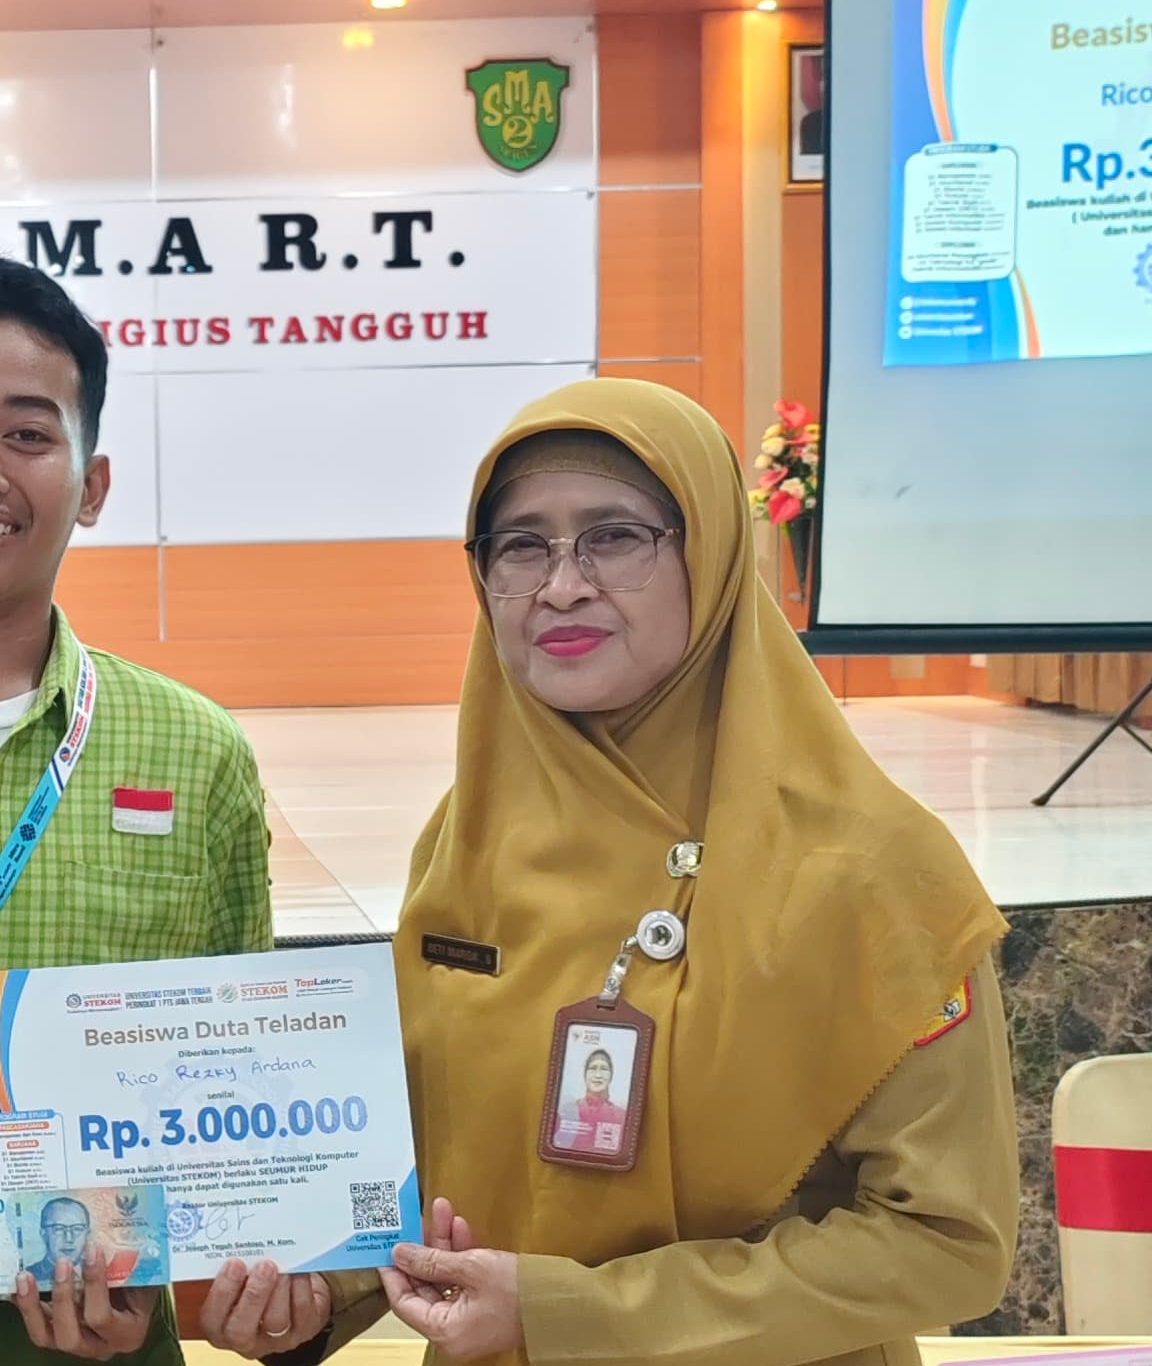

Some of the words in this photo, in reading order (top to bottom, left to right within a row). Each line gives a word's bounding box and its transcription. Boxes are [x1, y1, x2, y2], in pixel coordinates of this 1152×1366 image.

[1051, 17, 1152, 50] Beasis
[483, 70, 554, 126] SMA
[503, 116, 533, 148] 2
[104, 318, 231, 348] IGIUS
[248, 311, 489, 345] TANGGUH
[84, 1024, 189, 1046] Beasiswa
[195, 1020, 249, 1039] Duta
[254, 1012, 347, 1035] Teladan
[178, 1047, 219, 1058] Diberikan
[221, 1046, 256, 1056] kepada:
[117, 1071, 158, 1087] Rico
[251, 1057, 317, 1075] Ardana
[207, 1090, 235, 1100] senilai
[79, 1114, 151, 1159] Rp.
[159, 1095, 368, 1145] 3.000.000
[96, 1167, 136, 1176] Beasiswa
[137, 1165, 164, 1173] kuliah
[166, 1163, 175, 1171] di
[177, 1161, 225, 1171] Universitas
[227, 1159, 250, 1167] Sains
[252, 1157, 268, 1165] dan
[271, 1155, 313, 1164] Teknologi
[315, 1151, 359, 1161] Komputer
[128, 1176, 180, 1187] (Universitas
[181, 1172, 222, 1181] STEKOM)
[224, 1170, 256, 1178] berlaku
[258, 1166, 296, 1175] SEUMUR
[298, 1164, 328, 1172] HIDUP
[194, 1182, 219, 1191] dapat
[222, 1180, 267, 1190] digunakan
[269, 1177, 288, 1185] satu
[248, 1196, 279, 1205] STEKOM
